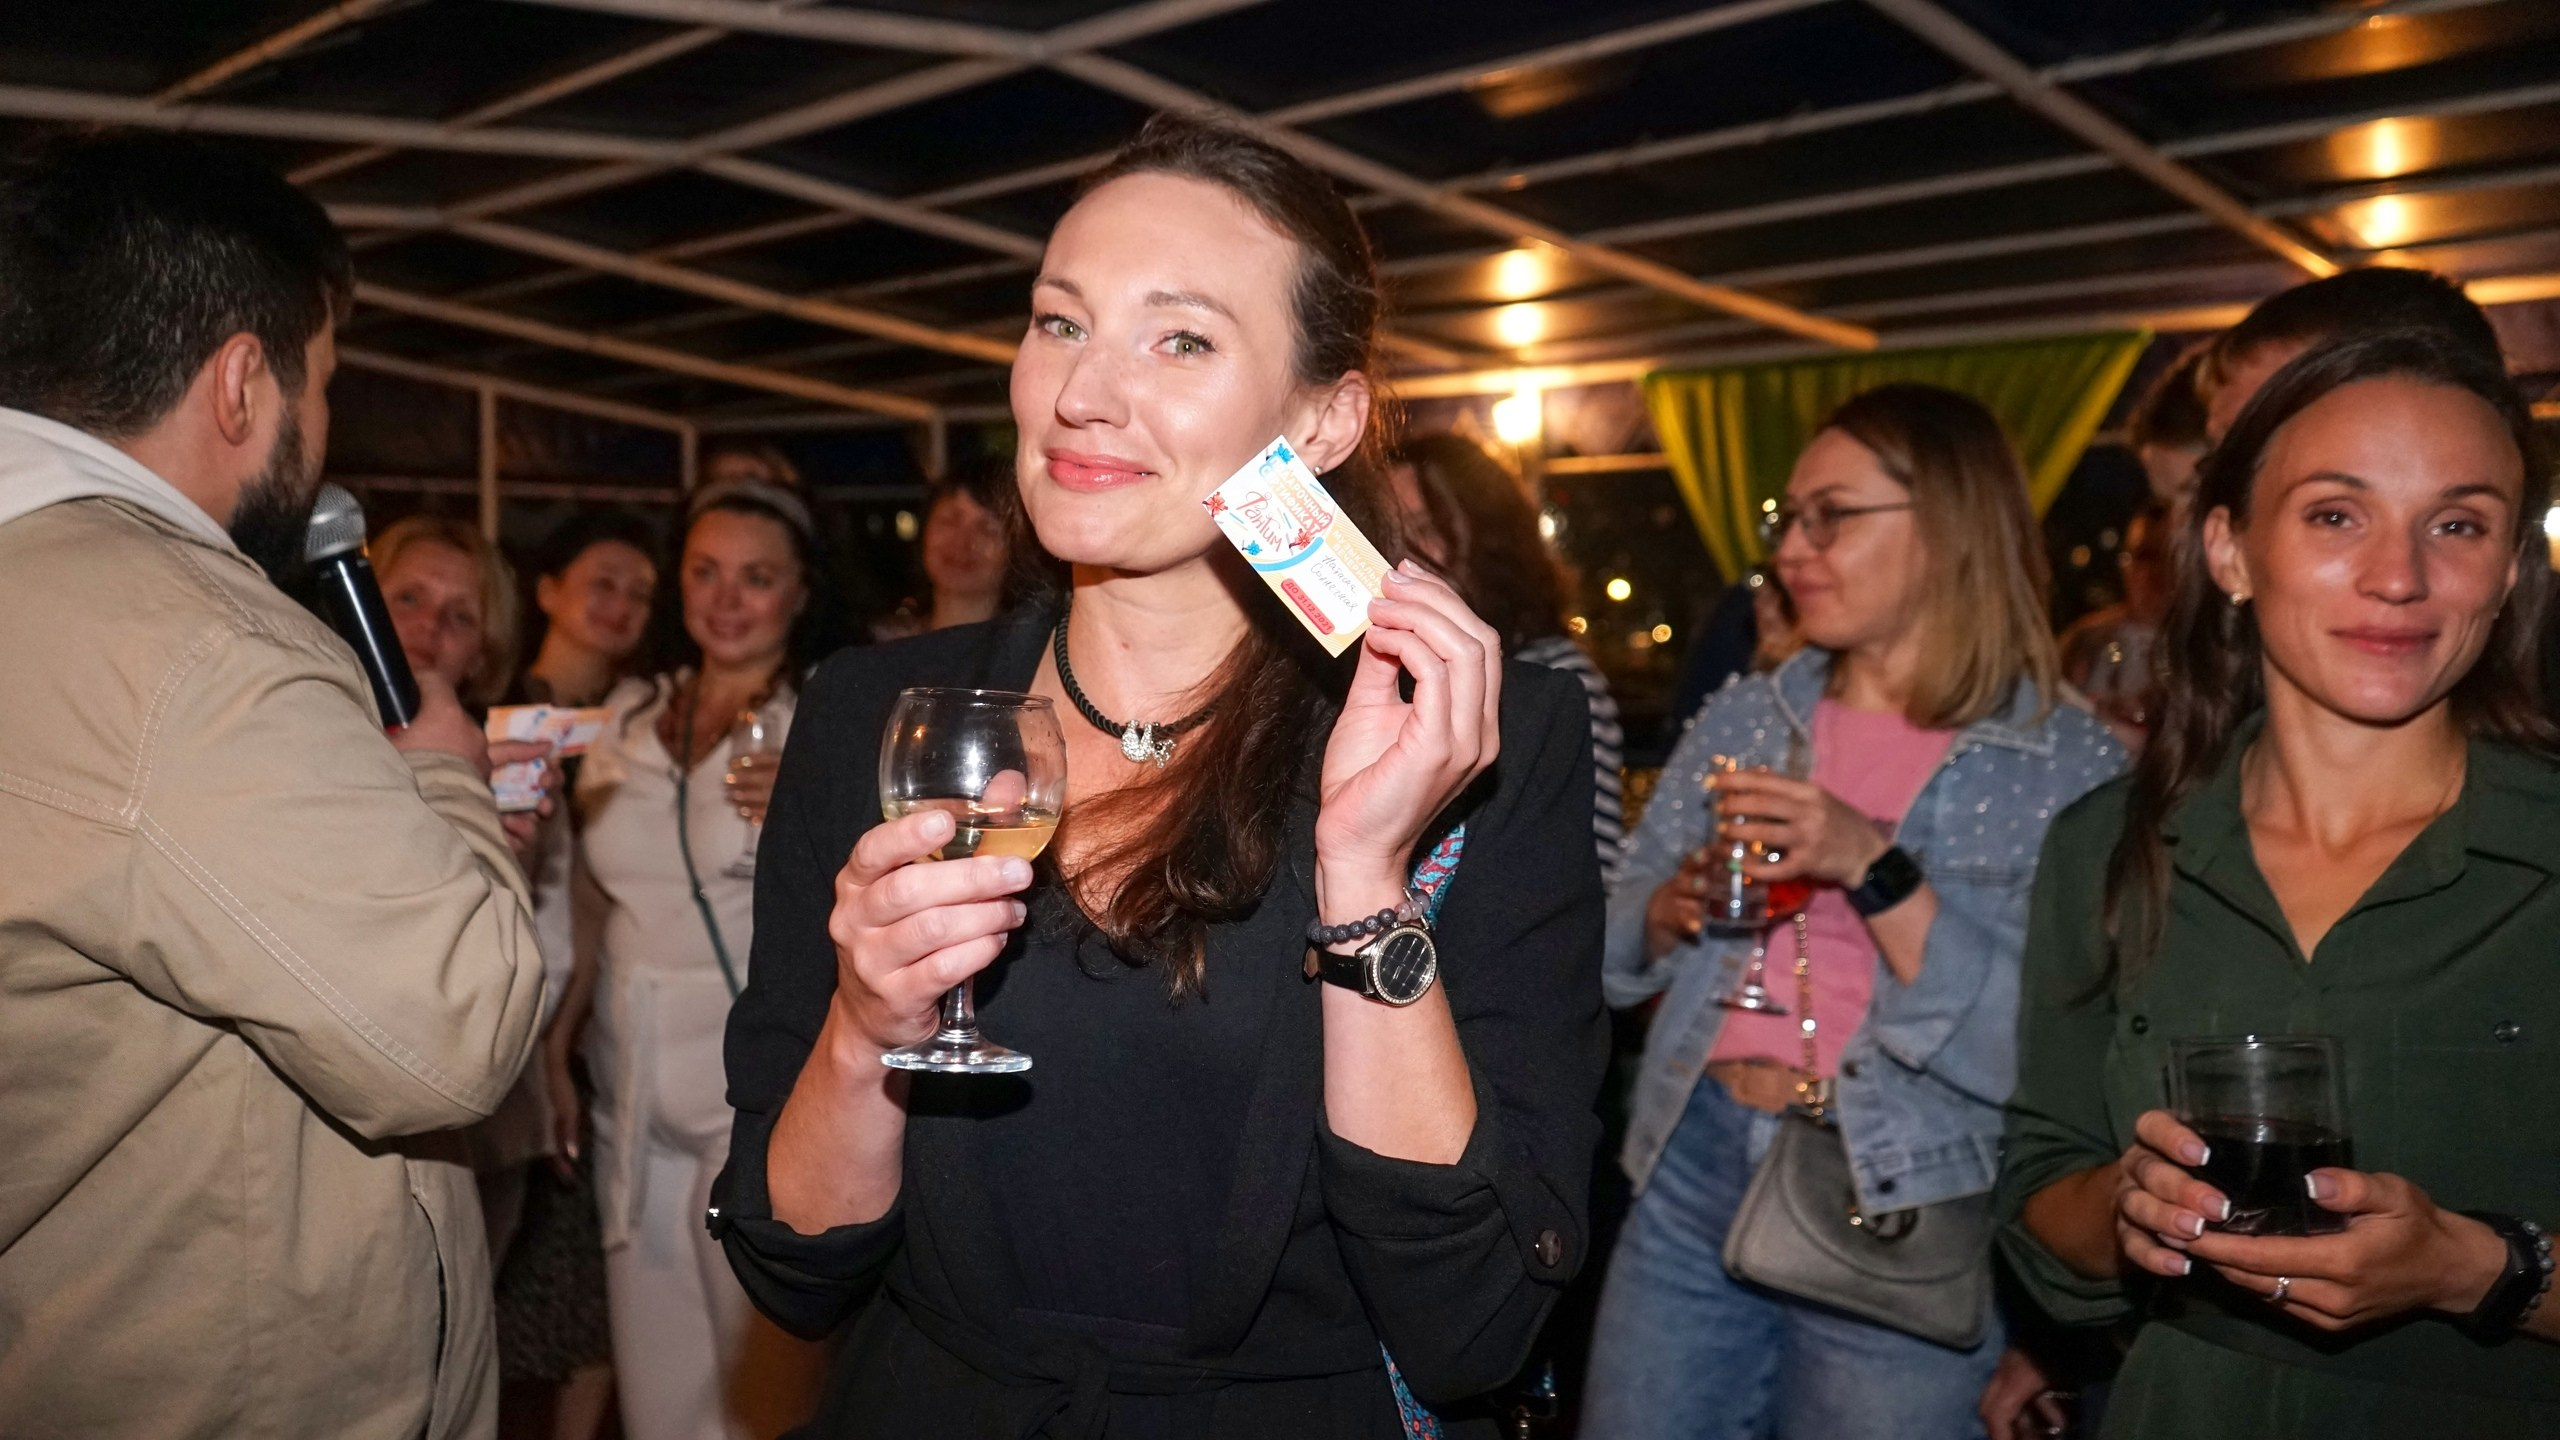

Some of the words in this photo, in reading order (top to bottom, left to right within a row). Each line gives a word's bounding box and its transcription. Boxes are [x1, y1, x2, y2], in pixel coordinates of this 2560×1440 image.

[1331, 529, 1382, 586] МУЗЫКАЛЬН
[1285, 581, 1299, 594] ДО
[1296, 593, 1332, 631] 31.12.2021
